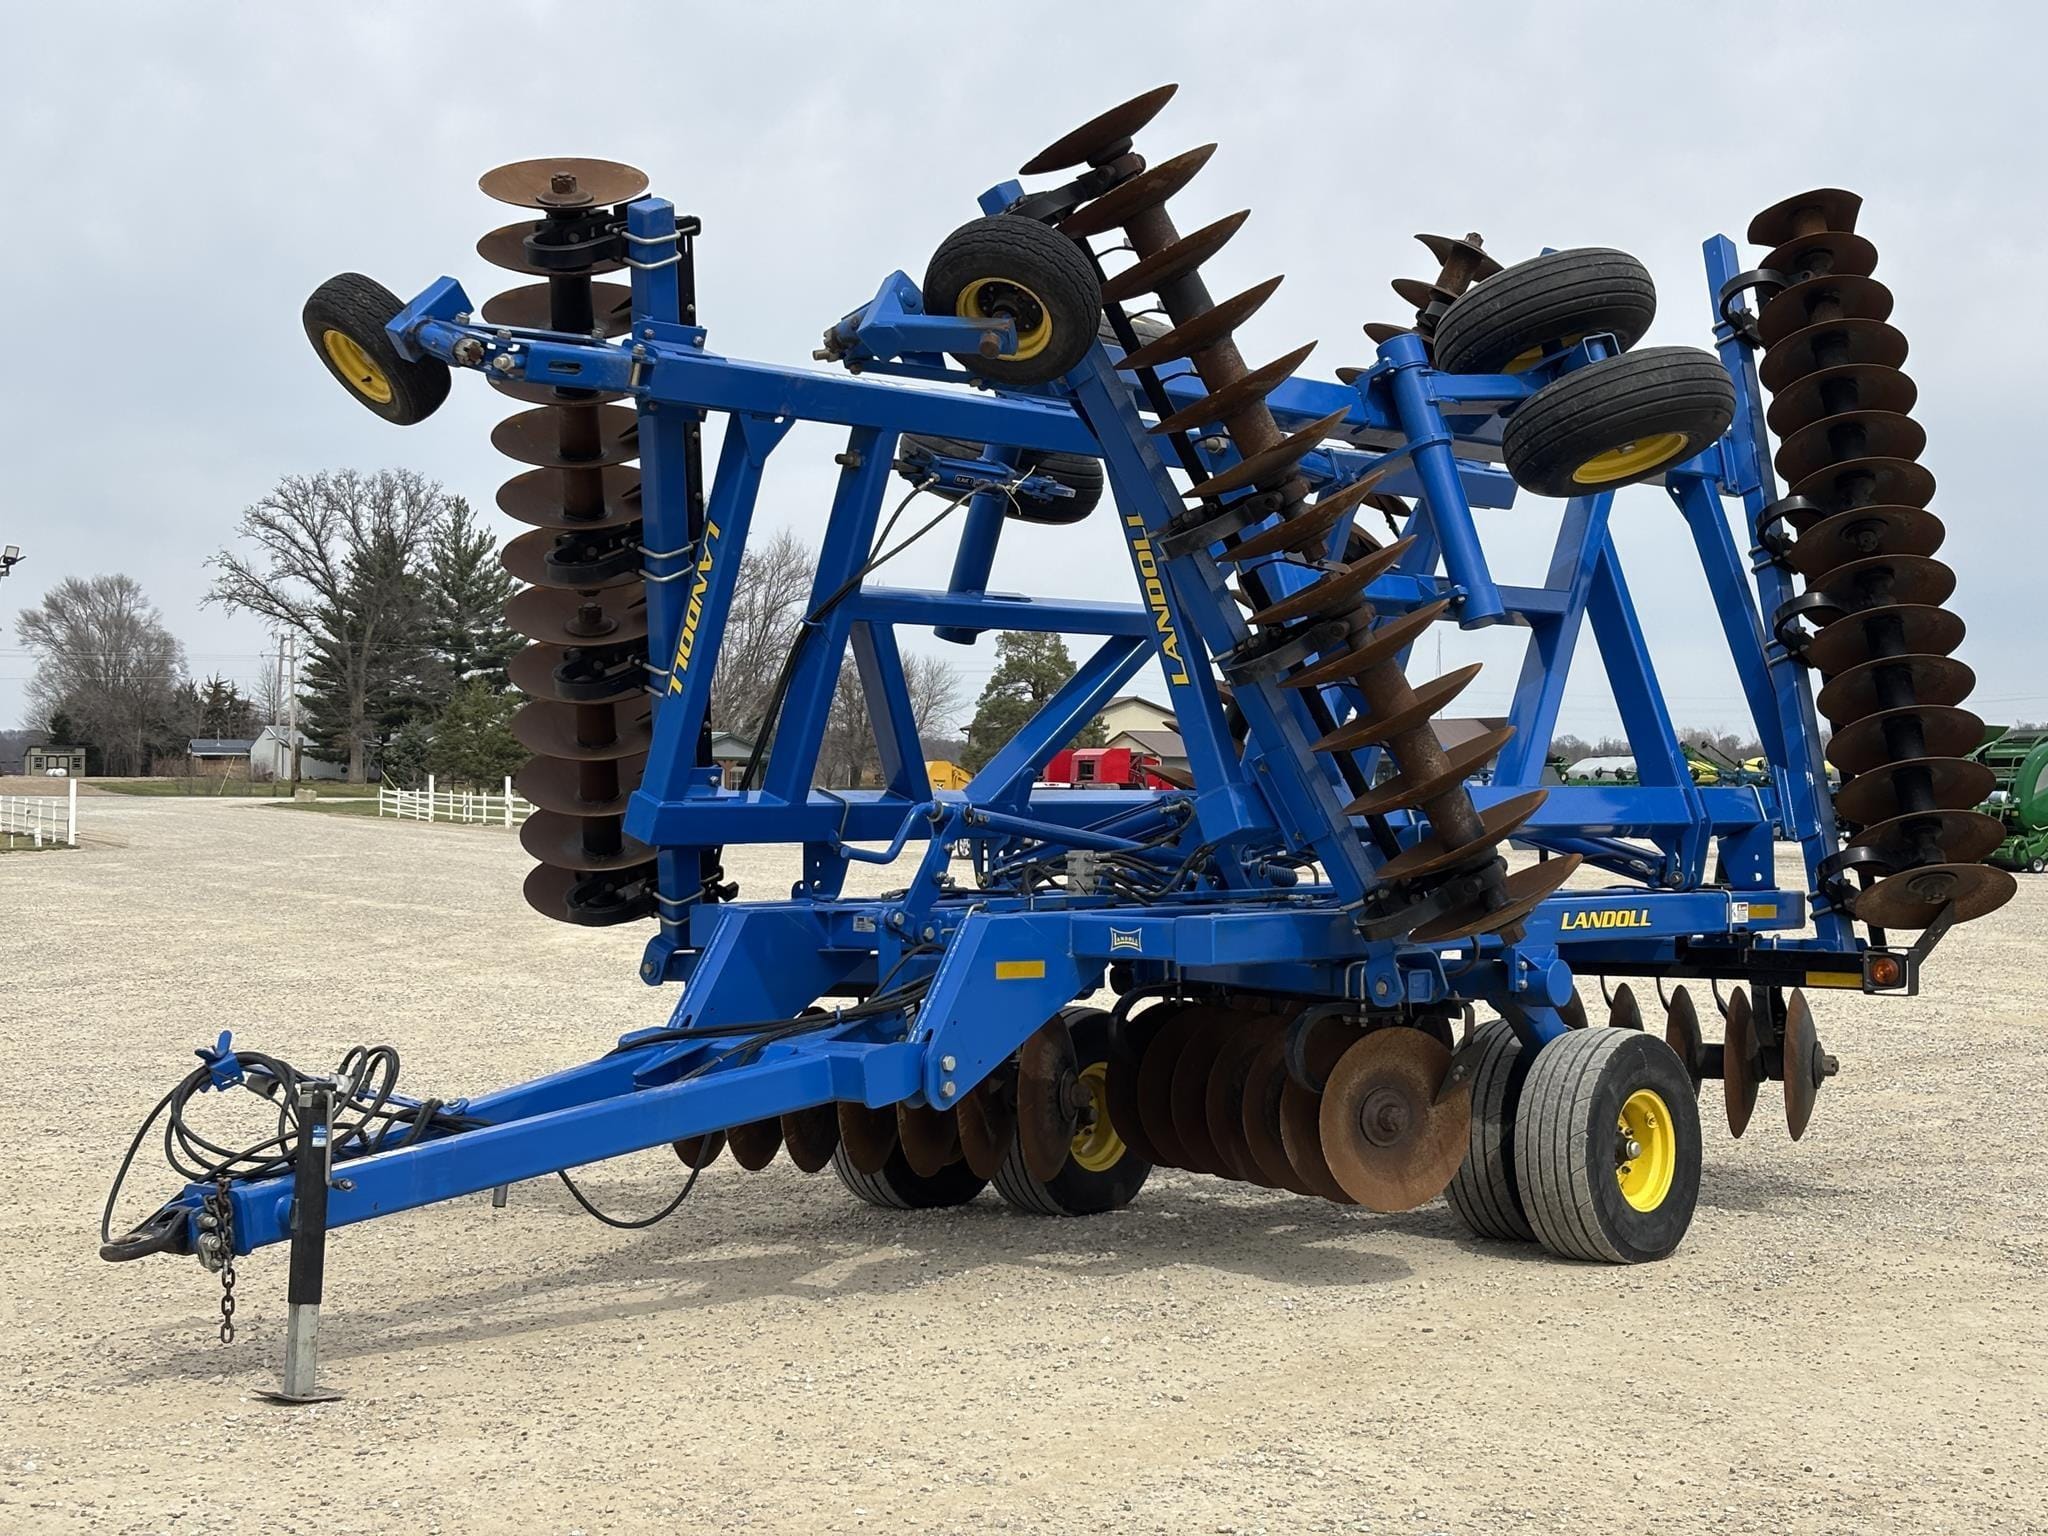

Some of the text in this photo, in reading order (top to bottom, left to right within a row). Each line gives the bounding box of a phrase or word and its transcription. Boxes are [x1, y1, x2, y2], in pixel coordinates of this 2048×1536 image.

[667, 519, 720, 697] LANDOLL
[1126, 512, 1190, 685] LANDOLL
[1560, 908, 1652, 931] LANDOLL
